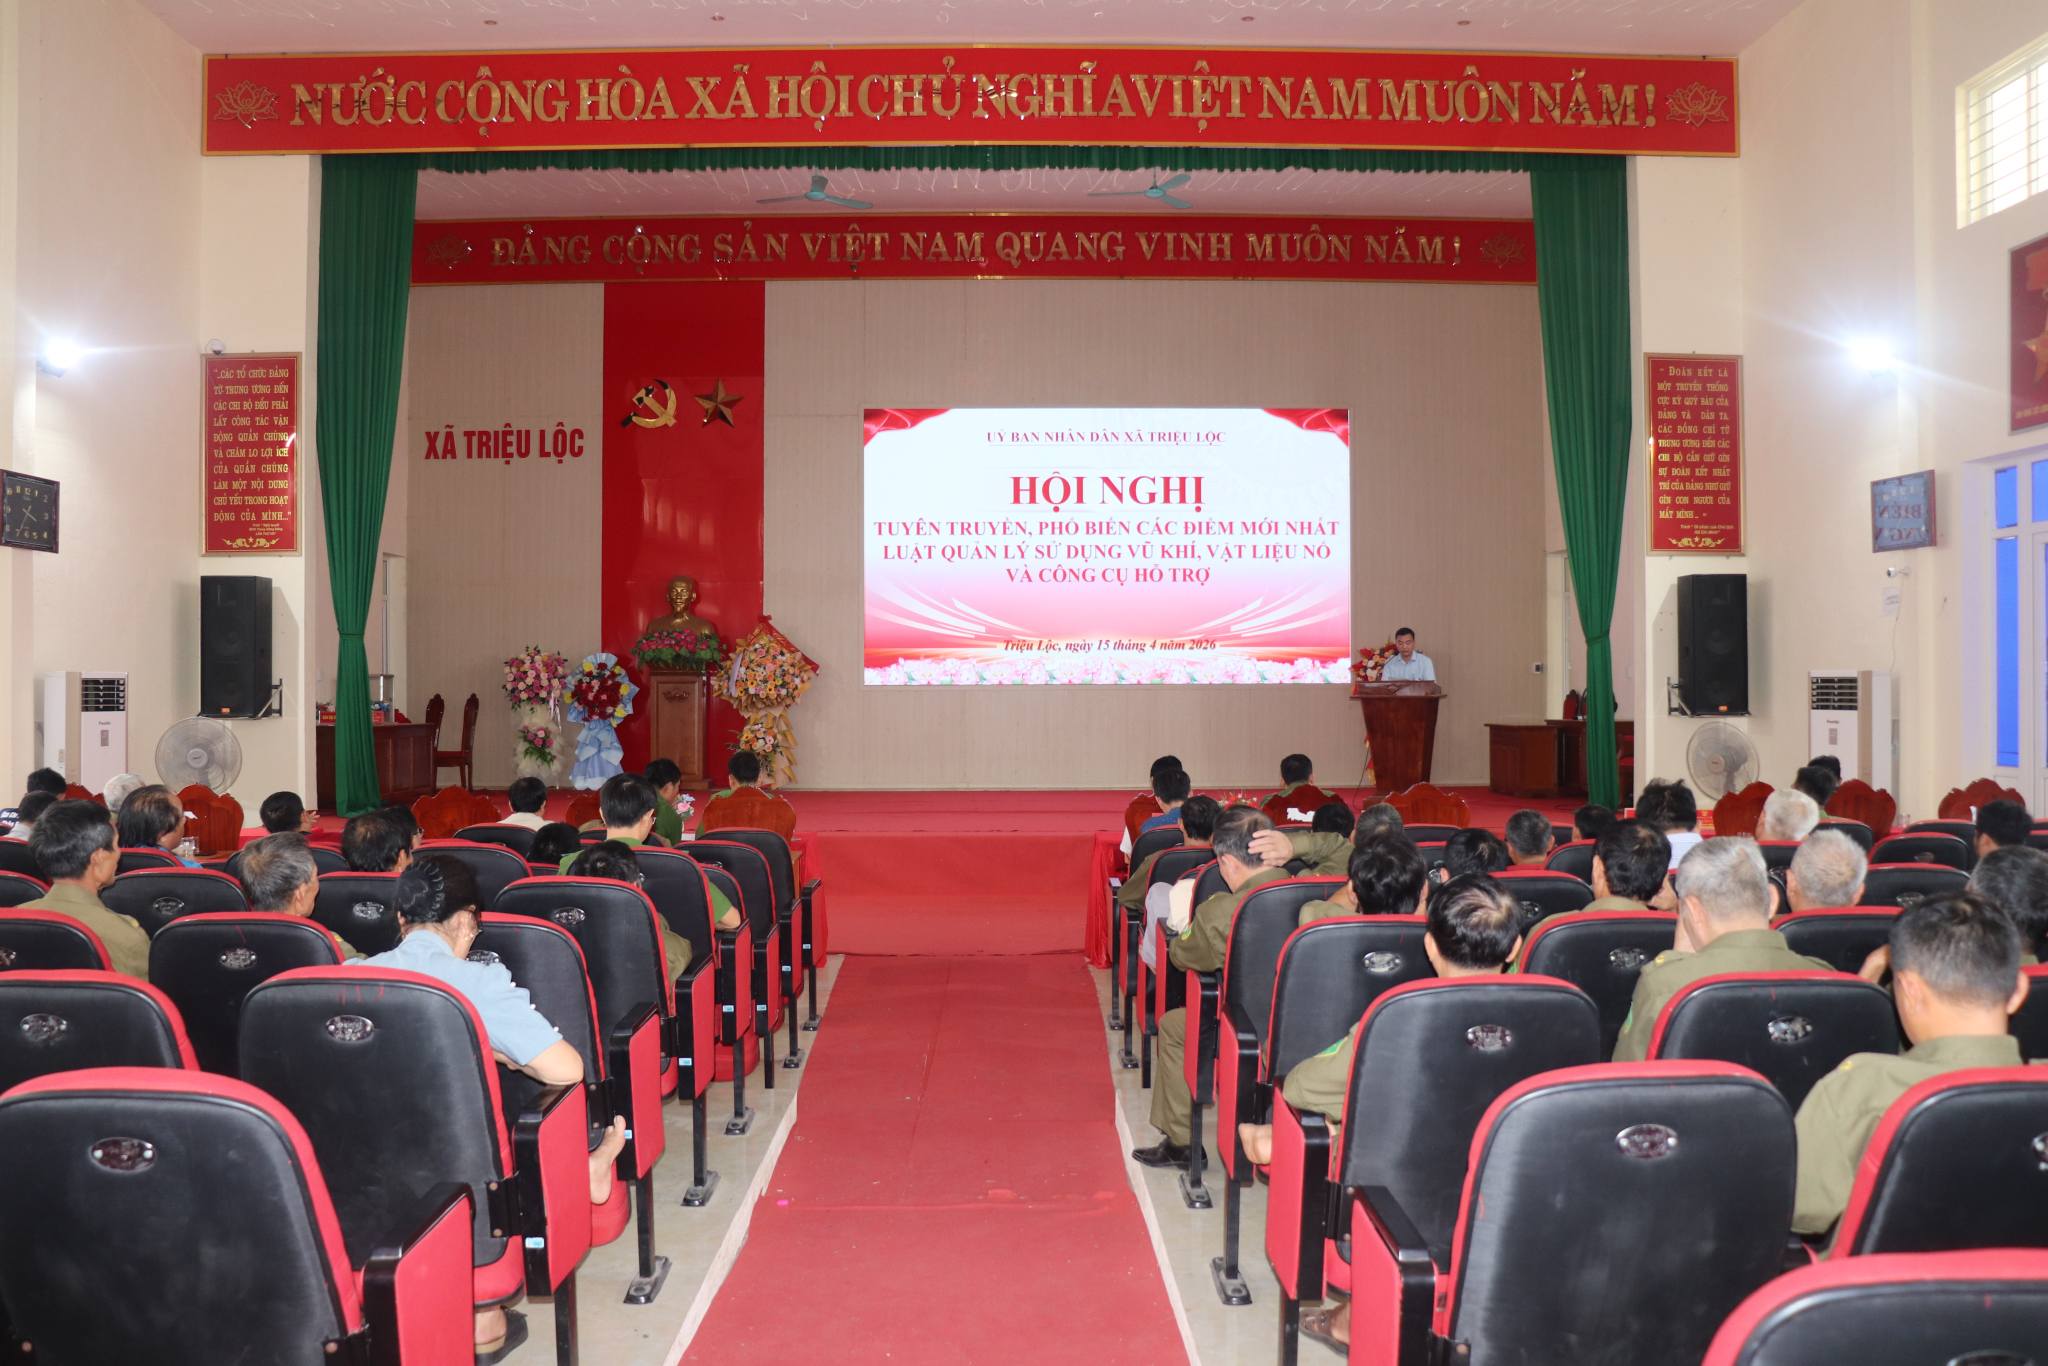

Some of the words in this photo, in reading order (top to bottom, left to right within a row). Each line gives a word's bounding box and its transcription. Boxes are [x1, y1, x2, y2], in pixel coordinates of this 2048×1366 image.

[290, 67, 426, 125] NƯỚC
[436, 66, 569, 136] CỘNG
[576, 64, 679, 120] HÒA
[685, 63, 759, 119] XÃ
[764, 61, 853, 130] HỘI
[858, 56, 965, 117] CHỦ
[1130, 60, 1252, 132] VIỆT
[1257, 76, 1372, 120] NAM
[1378, 65, 1522, 124] MUÔN
[491, 224, 591, 265] ĐẢNG
[603, 226, 700, 274] CỘNG
[713, 221, 788, 262] SẢN
[800, 224, 890, 272] VIỆT
[900, 232, 984, 261] NAM
[996, 232, 1125, 267] QUANG
[1136, 232, 1233, 261] VINH
[1245, 224, 1352, 263] MUÔN
[425, 424, 456, 459] XÃ
[464, 423, 530, 465] TRIỆU
[539, 422, 583, 464] LỘC
[1012, 432, 1039, 442] BAN
[1045, 428, 1085, 442] NHÂN
[1090, 428, 1120, 442] DÂN
[1125, 429, 1144, 442] XÃ
[1148, 431, 1192, 445] TRIỆU
[1196, 431, 1226, 445] LỘC
[249, 449, 258, 457] LO
[269, 480, 288, 488] DUNG
[1010, 471, 1086, 512] HỘI
[1099, 475, 1205, 512] NGHỊ
[245, 496, 267, 504] TRONG
[874, 518, 940, 535] TUYÊN
[1137, 517, 1178, 535] CÁC
[1240, 517, 1278, 535] MỚI
[884, 542, 935, 563] LUẬT
[941, 541, 997, 562] QUẢN
[1003, 541, 1028, 559] LÝ
[1034, 541, 1061, 559] SỬ
[1066, 545, 1122, 562] DỤNG
[1127, 541, 1153, 559] VŨ
[1161, 541, 1201, 560] KHÍ,
[1207, 542, 1246, 562] VẬT
[1252, 542, 1297, 562] LIỆU
[1007, 564, 1033, 582] VÀ
[1039, 564, 1096, 583] CÔNG
[1102, 568, 1128, 586] CỤ
[1169, 567, 1210, 586] TRỢ
[1004, 640, 1033, 653] Triệu
[1065, 641, 1093, 653] ngày
[1097, 640, 1109, 650] 15
[1113, 640, 1146, 653] tháng
[1150, 640, 1156, 650] 4
[1160, 641, 1184, 650] năm
[1189, 640, 1216, 650] 2026
